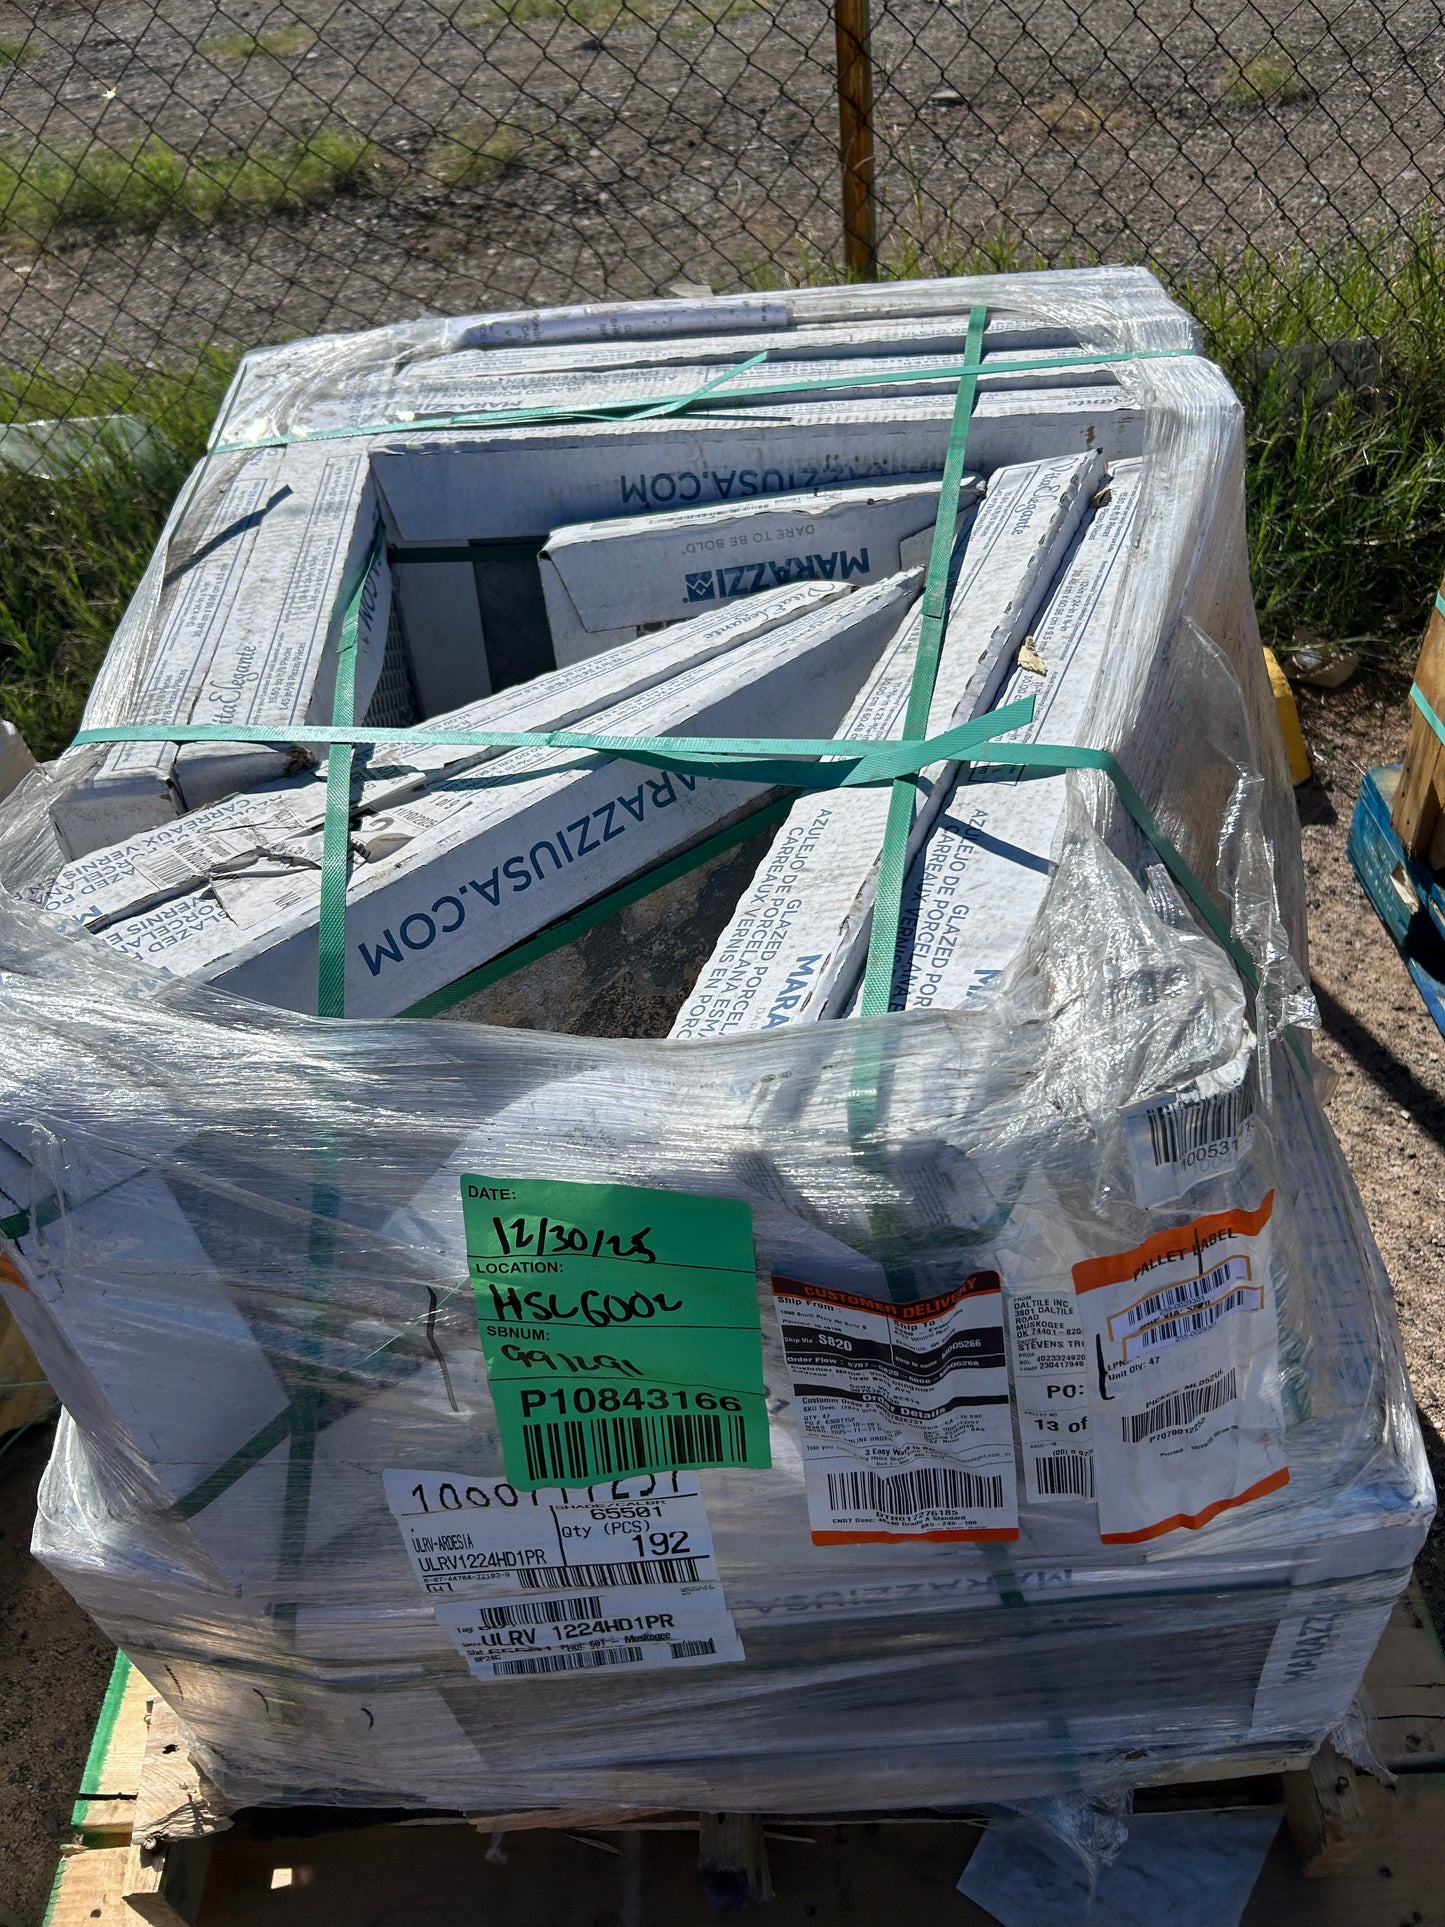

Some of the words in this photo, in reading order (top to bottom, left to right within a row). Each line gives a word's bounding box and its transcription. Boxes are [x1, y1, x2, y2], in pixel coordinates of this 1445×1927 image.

[730, 535, 748, 548] BE
[753, 532, 775, 543] TO
[777, 524, 815, 539] DARE
[715, 548, 870, 599] MARAZZI
[789, 808, 833, 870] AZULEJO
[949, 808, 990, 872] AZULEJO
[62, 845, 139, 879] VERNIS
[751, 827, 804, 904] CARREAUX
[358, 770, 713, 977] ARAZZIUSA.COM
[776, 874, 798, 894] DE
[937, 875, 960, 896] DE
[718, 908, 758, 964] VERNIS
[761, 899, 803, 962] GLAZED
[931, 904, 970, 969] GLAZED
[721, 898, 785, 994] PORCELANA
[704, 967, 728, 989] EN
[718, 966, 770, 1035] PORCEL
[468, 1185, 516, 1200] DATE:
[1134, 1248, 1185, 1281] PALLET
[1192, 1227, 1238, 1257] LABEL
[476, 1261, 563, 1274] LOCATION:
[804, 1286, 897, 1315] CUSTOMER
[903, 1277, 976, 1318] DELIVERY
[1014, 1299, 1050, 1310] DALTILE
[1054, 1299, 1069, 1308] INC
[1015, 1308, 1035, 1317] 3801
[1038, 1307, 1074, 1315] DALTILE
[1015, 1314, 1039, 1324] ROAD
[487, 1326, 550, 1341] SBNUM:
[1016, 1321, 1064, 1331] MUSKOGEE
[818, 1334, 853, 1352] S820
[1018, 1341, 1064, 1351] STEVENS
[1108, 1371, 1127, 1380] Unit
[1149, 1356, 1160, 1365] 47
[520, 1387, 742, 1417] P10843166
[1047, 1385, 1084, 1398] PO:
[862, 1394, 895, 1412] Order
[901, 1407, 946, 1419] Details
[1034, 1419, 1059, 1431] 13
[1068, 1416, 1087, 1432] of
[872, 1448, 890, 1456] Easy
[591, 1506, 662, 1520] 65501
[562, 1524, 591, 1540] Qty
[604, 1520, 650, 1535] (PCS)
[412, 1536, 474, 1553] ULRV-ARDESIA
[632, 1531, 691, 1557] 192
[419, 1550, 547, 1572] ULRV1224HD1PR
[481, 1628, 536, 1647] ULRV
[552, 1613, 674, 1641] 1224HD1PR
[625, 1631, 671, 1643] Muskogee
